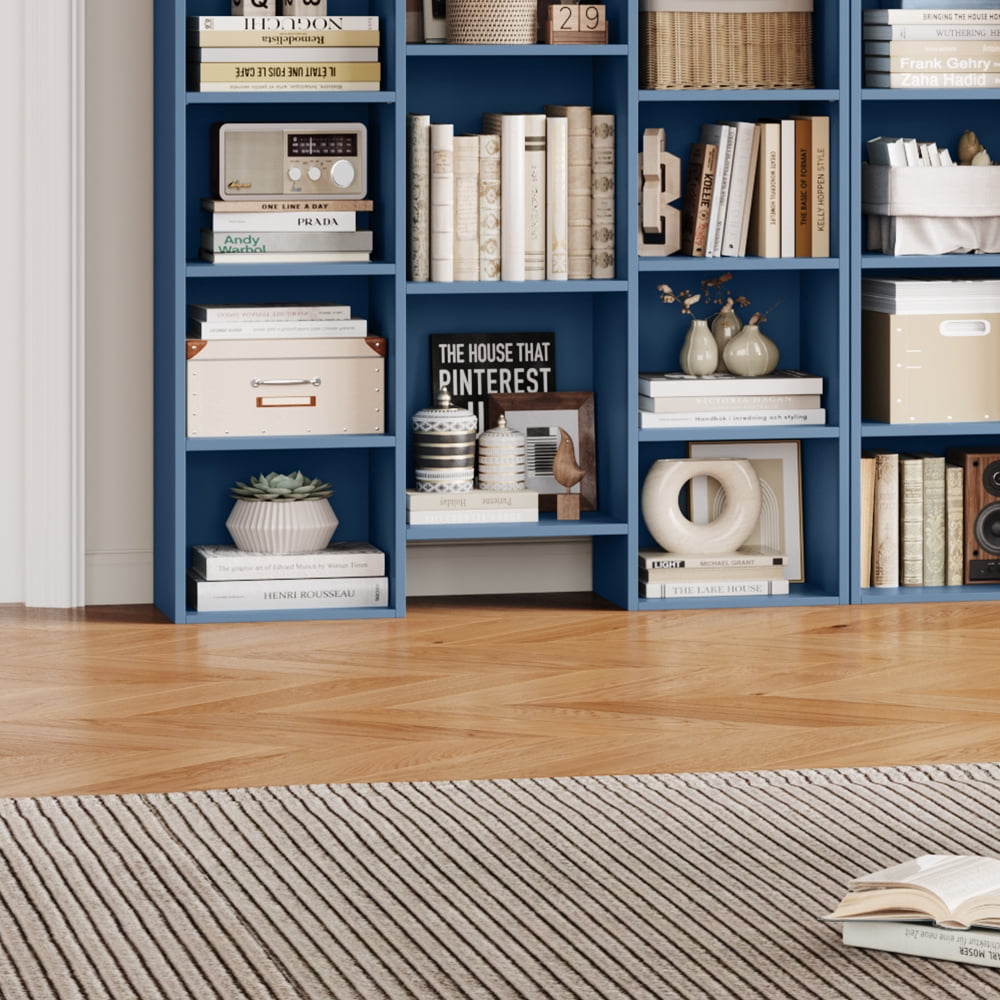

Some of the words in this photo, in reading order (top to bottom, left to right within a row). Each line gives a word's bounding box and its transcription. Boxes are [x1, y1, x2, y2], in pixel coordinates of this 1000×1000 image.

[923, 13, 953, 21] BRINGING
[244, 18, 343, 30] NOGUCHI
[261, 35, 324, 44] Remodelista
[900, 58, 941, 69] Frank
[946, 58, 991, 71] Gehry
[236, 66, 256, 78] CAFÉ
[257, 66, 266, 77] LE
[268, 66, 286, 77] FOIS
[288, 66, 304, 77] UNE
[306, 66, 327, 78] ÉTAIT
[328, 66, 336, 76] IL
[901, 74, 938, 86] Zaha
[944, 74, 986, 86] Hadid
[800, 148, 808, 177] FORMAT
[800, 179, 808, 188] OF
[800, 190, 808, 210] BASIC
[298, 218, 339, 226] PRADA
[800, 212, 808, 226] THE
[224, 235, 260, 246] Andy
[218, 244, 266, 253] Warhol
[438, 344, 464, 364] THE
[468, 343, 514, 363] HOUSE
[516, 342, 550, 362] THAT
[438, 368, 552, 396] PINTEREST
[264, 591, 297, 600] HENRI
[300, 590, 356, 599] ROUSSEAU
[672, 586, 694, 595] THE
[697, 586, 725, 594] LAKE
[727, 584, 762, 594] HOUSE
[905, 928, 918, 941] Zeit
[920, 932, 938, 942] neue
[939, 934, 954, 944] eine
[957, 936, 968, 947] für
[959, 946, 985, 960] MOSER
